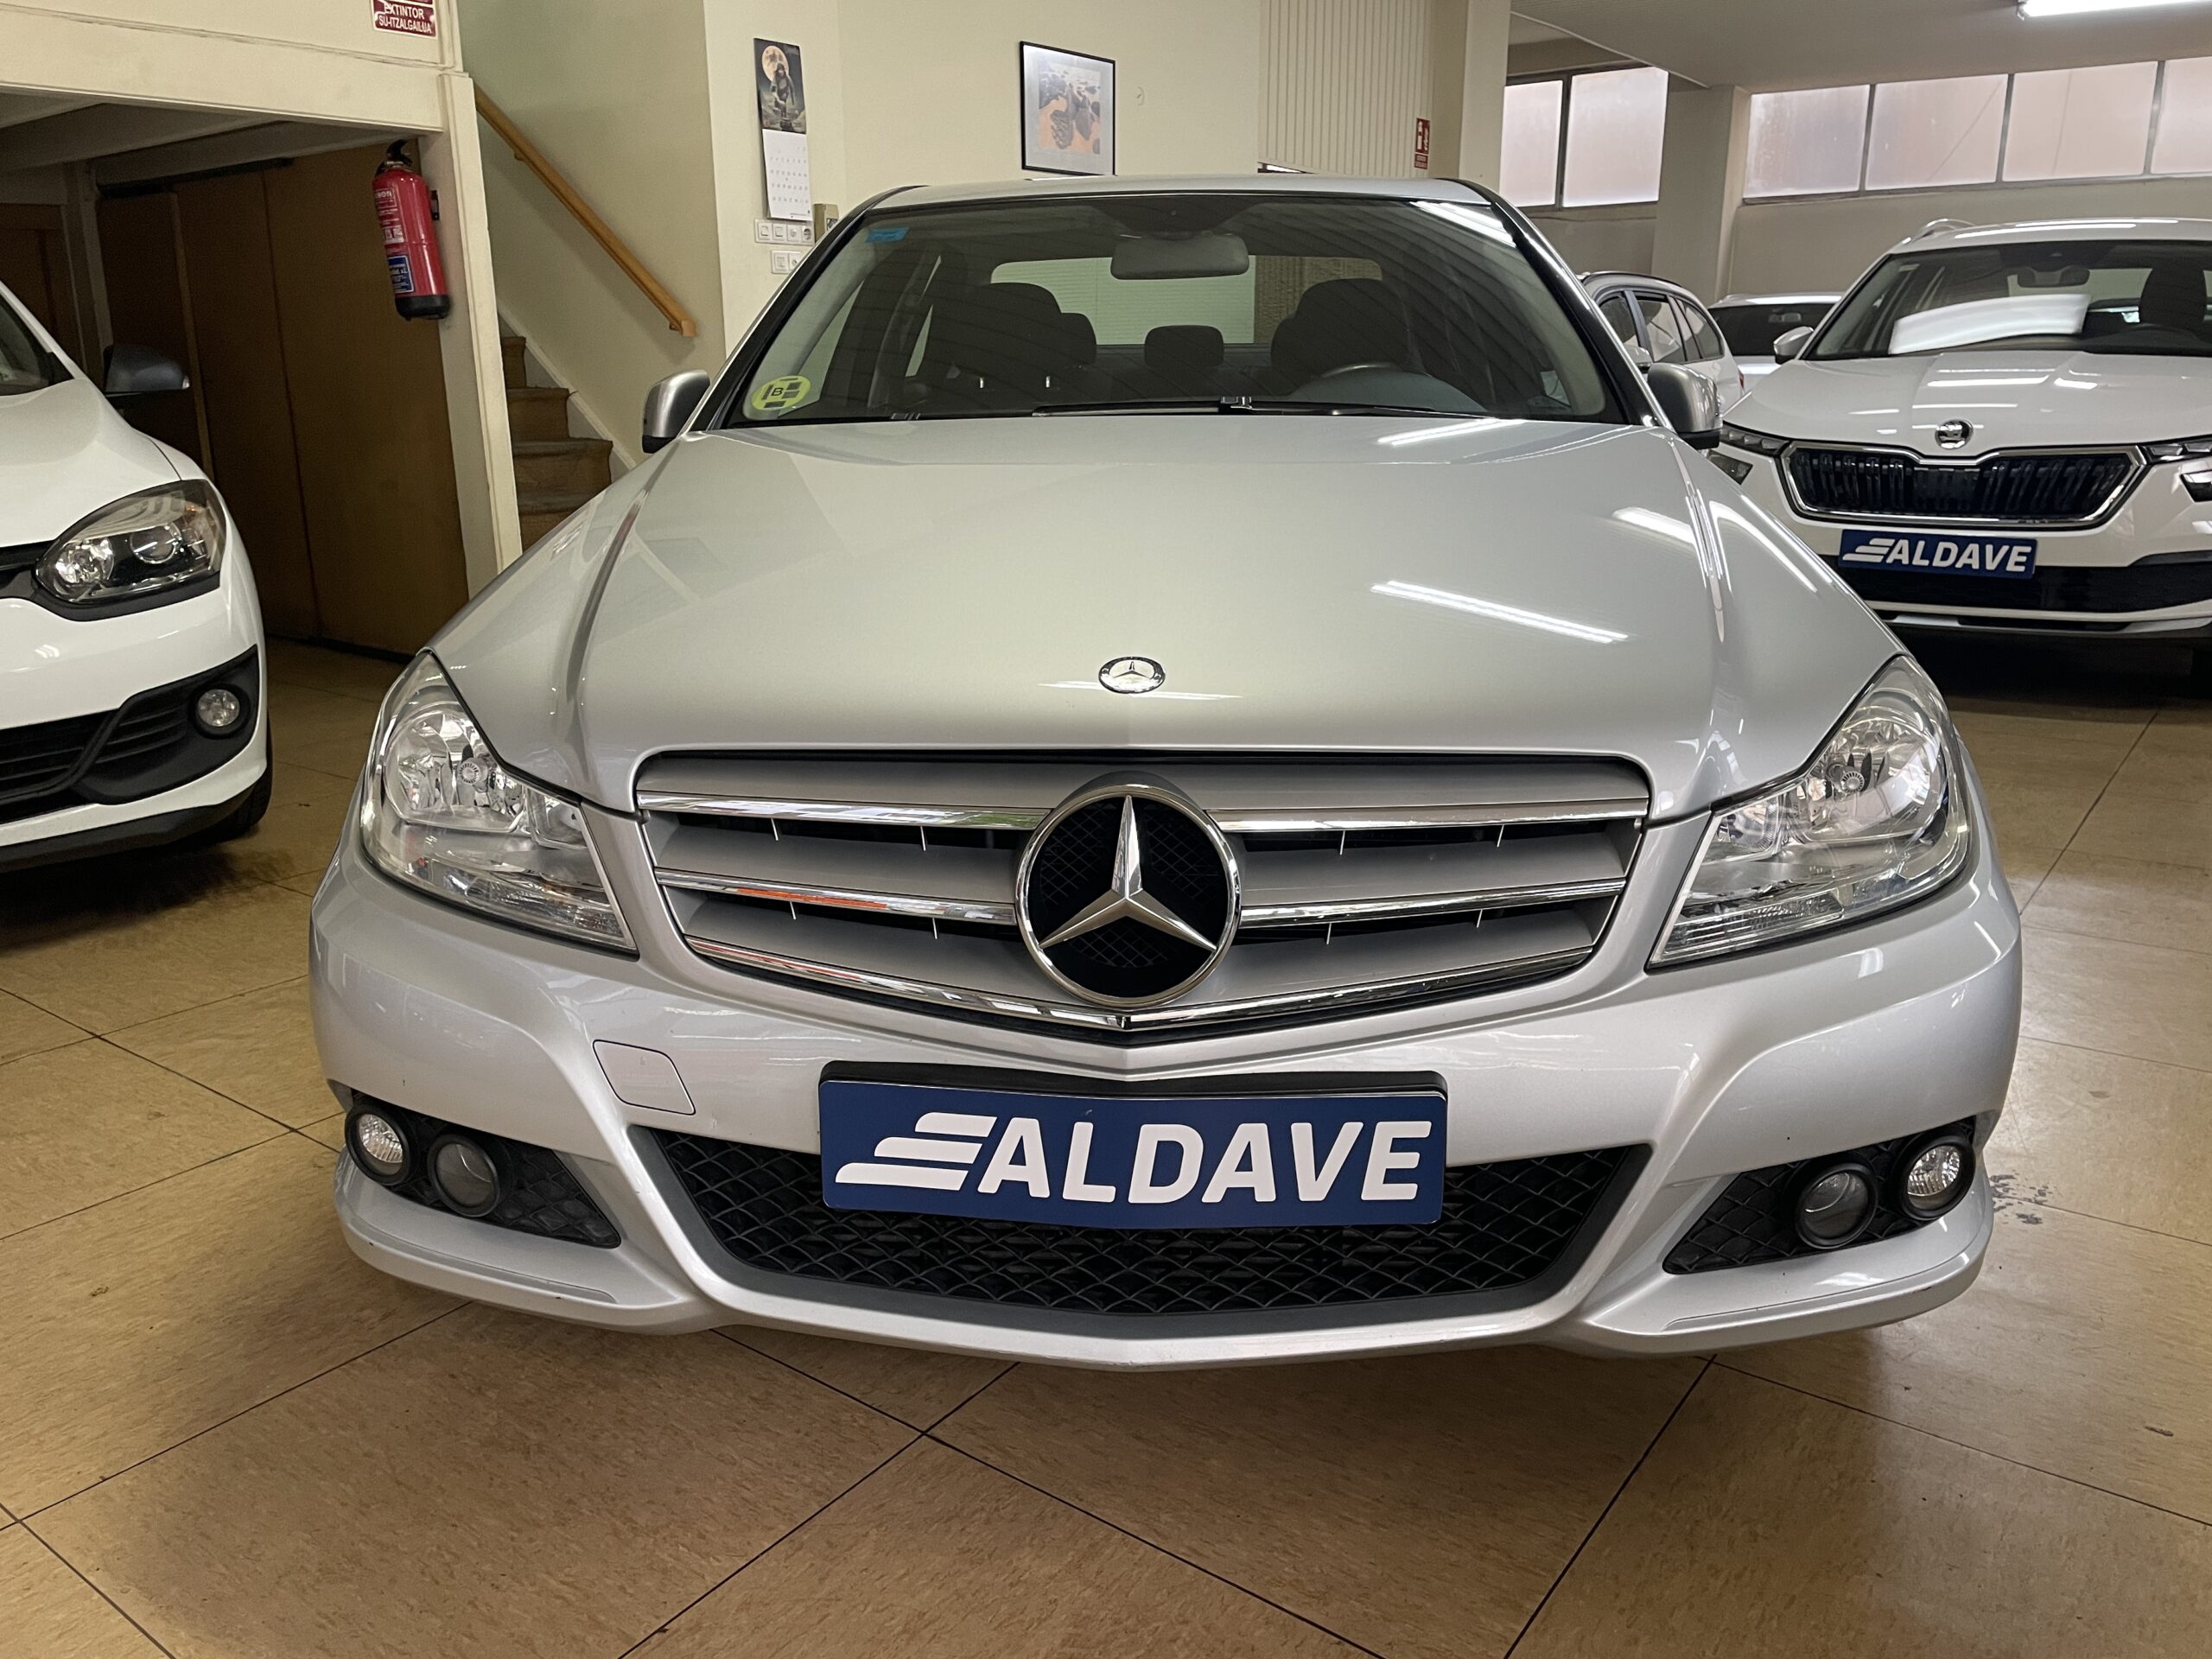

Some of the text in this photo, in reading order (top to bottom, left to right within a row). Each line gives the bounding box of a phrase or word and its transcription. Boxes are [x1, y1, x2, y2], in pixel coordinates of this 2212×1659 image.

[385, 3, 425, 20] EXTINTOR
[771, 387, 784, 396] B
[1885, 539, 2032, 572] ALDAVE
[978, 1117, 1432, 1204] ALDAVE
